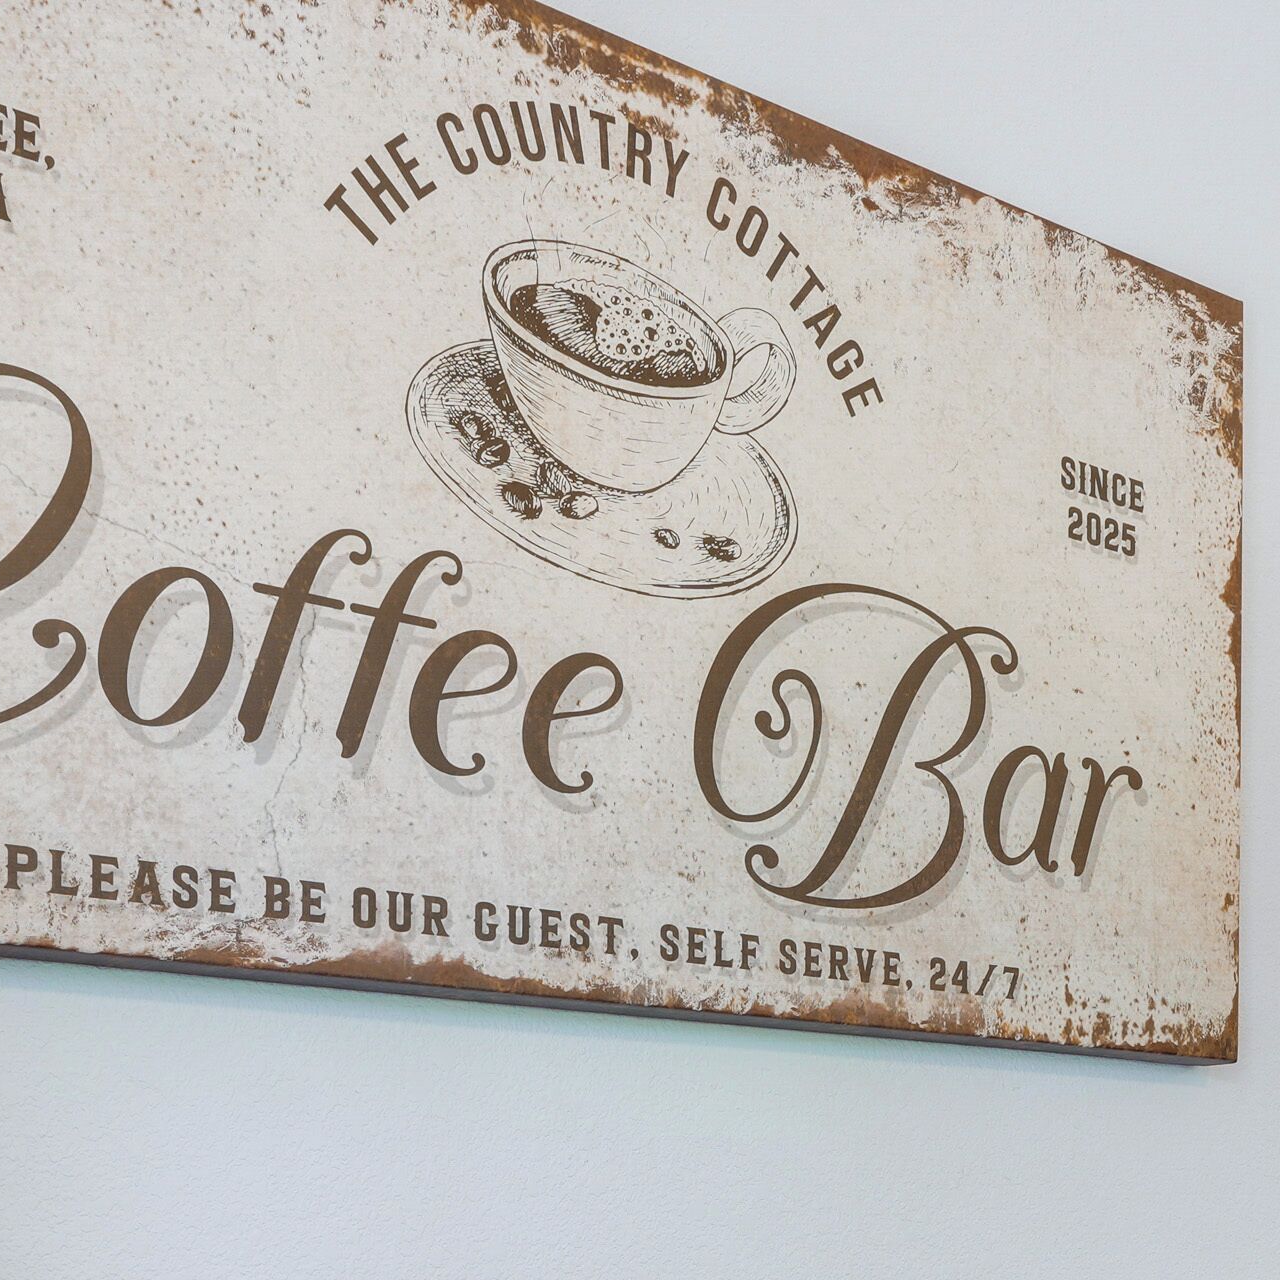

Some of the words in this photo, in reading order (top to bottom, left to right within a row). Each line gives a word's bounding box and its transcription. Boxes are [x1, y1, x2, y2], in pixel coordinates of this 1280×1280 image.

[323, 132, 438, 246] THE
[436, 101, 690, 199] COUNTRY
[706, 176, 885, 419] COTTAGE
[1060, 456, 1146, 514] SINCE
[1067, 506, 1138, 558] 2025
[693, 582, 1144, 909] Bar
[4, 843, 236, 914] PLEASE
[264, 875, 326, 924] BE
[352, 886, 450, 937] OUR
[473, 901, 640, 962] GUEST,
[660, 924, 760, 971] SELF
[778, 938, 914, 992] SERVE,
[929, 956, 1021, 1000] 24/7
